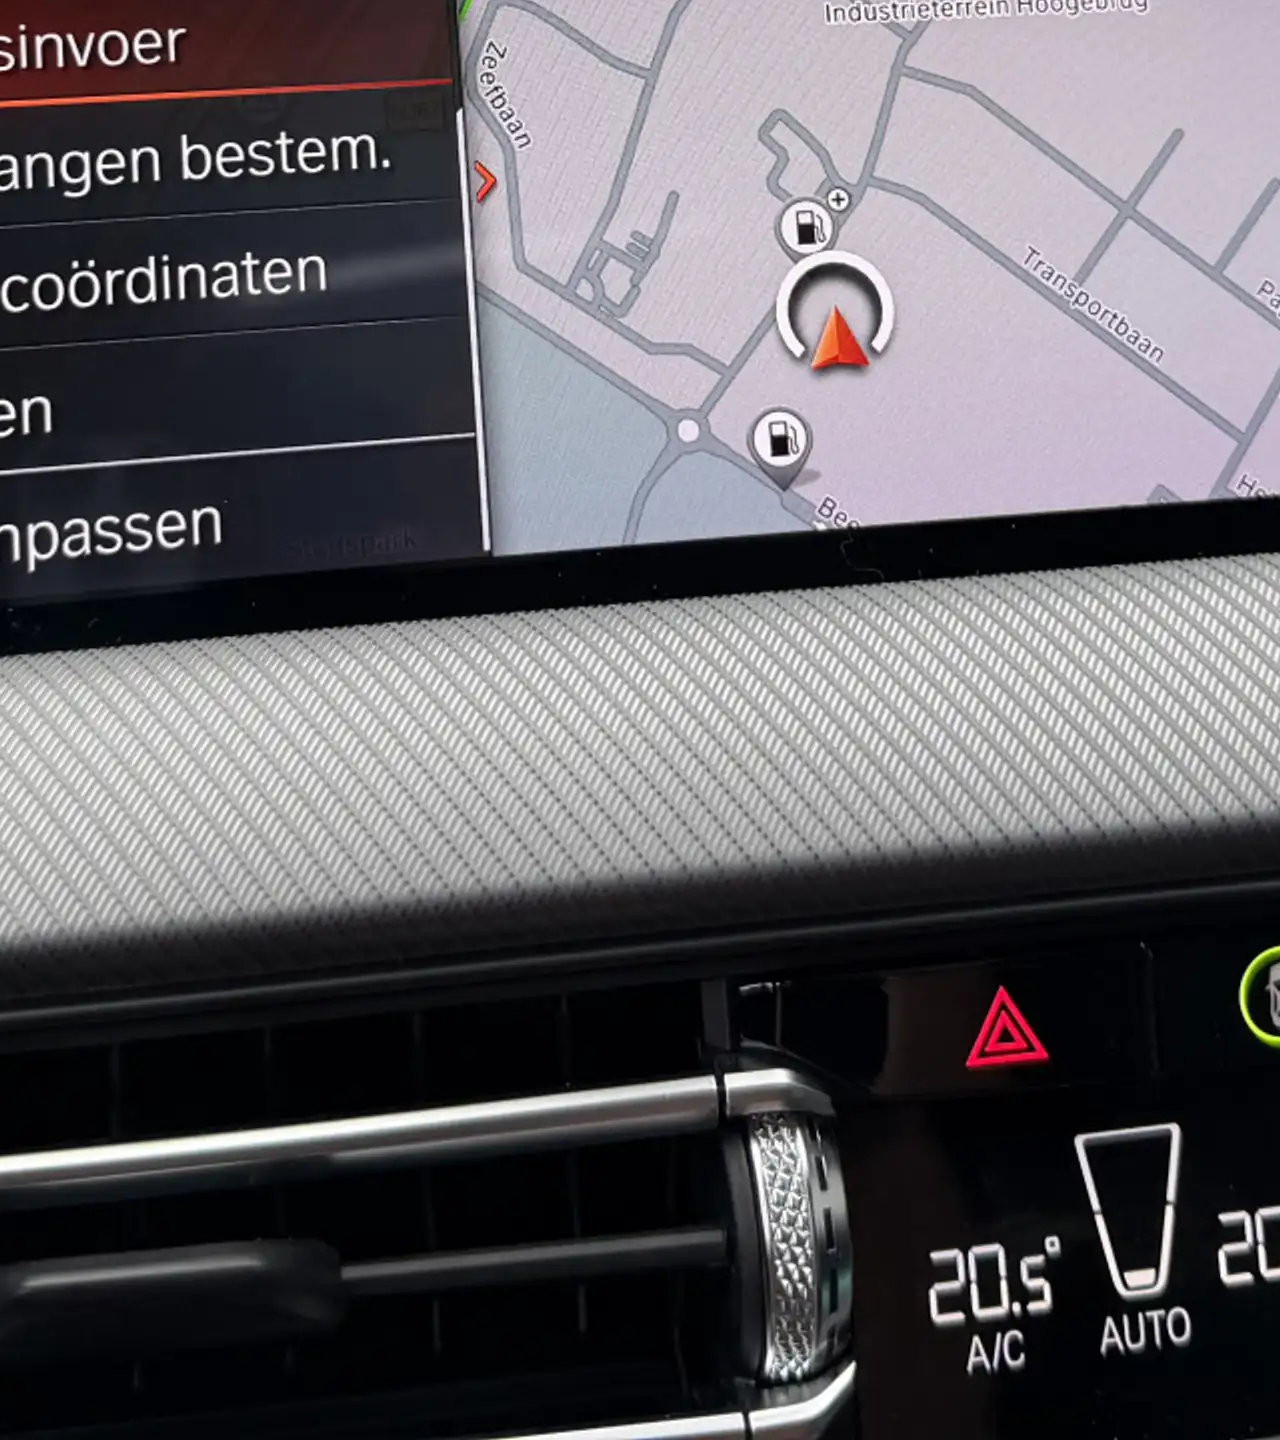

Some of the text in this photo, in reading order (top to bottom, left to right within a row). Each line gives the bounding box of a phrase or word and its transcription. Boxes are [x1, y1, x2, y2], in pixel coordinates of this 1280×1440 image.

[480, 41, 531, 149] Zeefbaan
[181, 131, 392, 180] bestem.
[1024, 245, 1164, 363] Transportbaan
[966, 1329, 1026, 1375] A/C
[1100, 1306, 1192, 1356] AUTO
